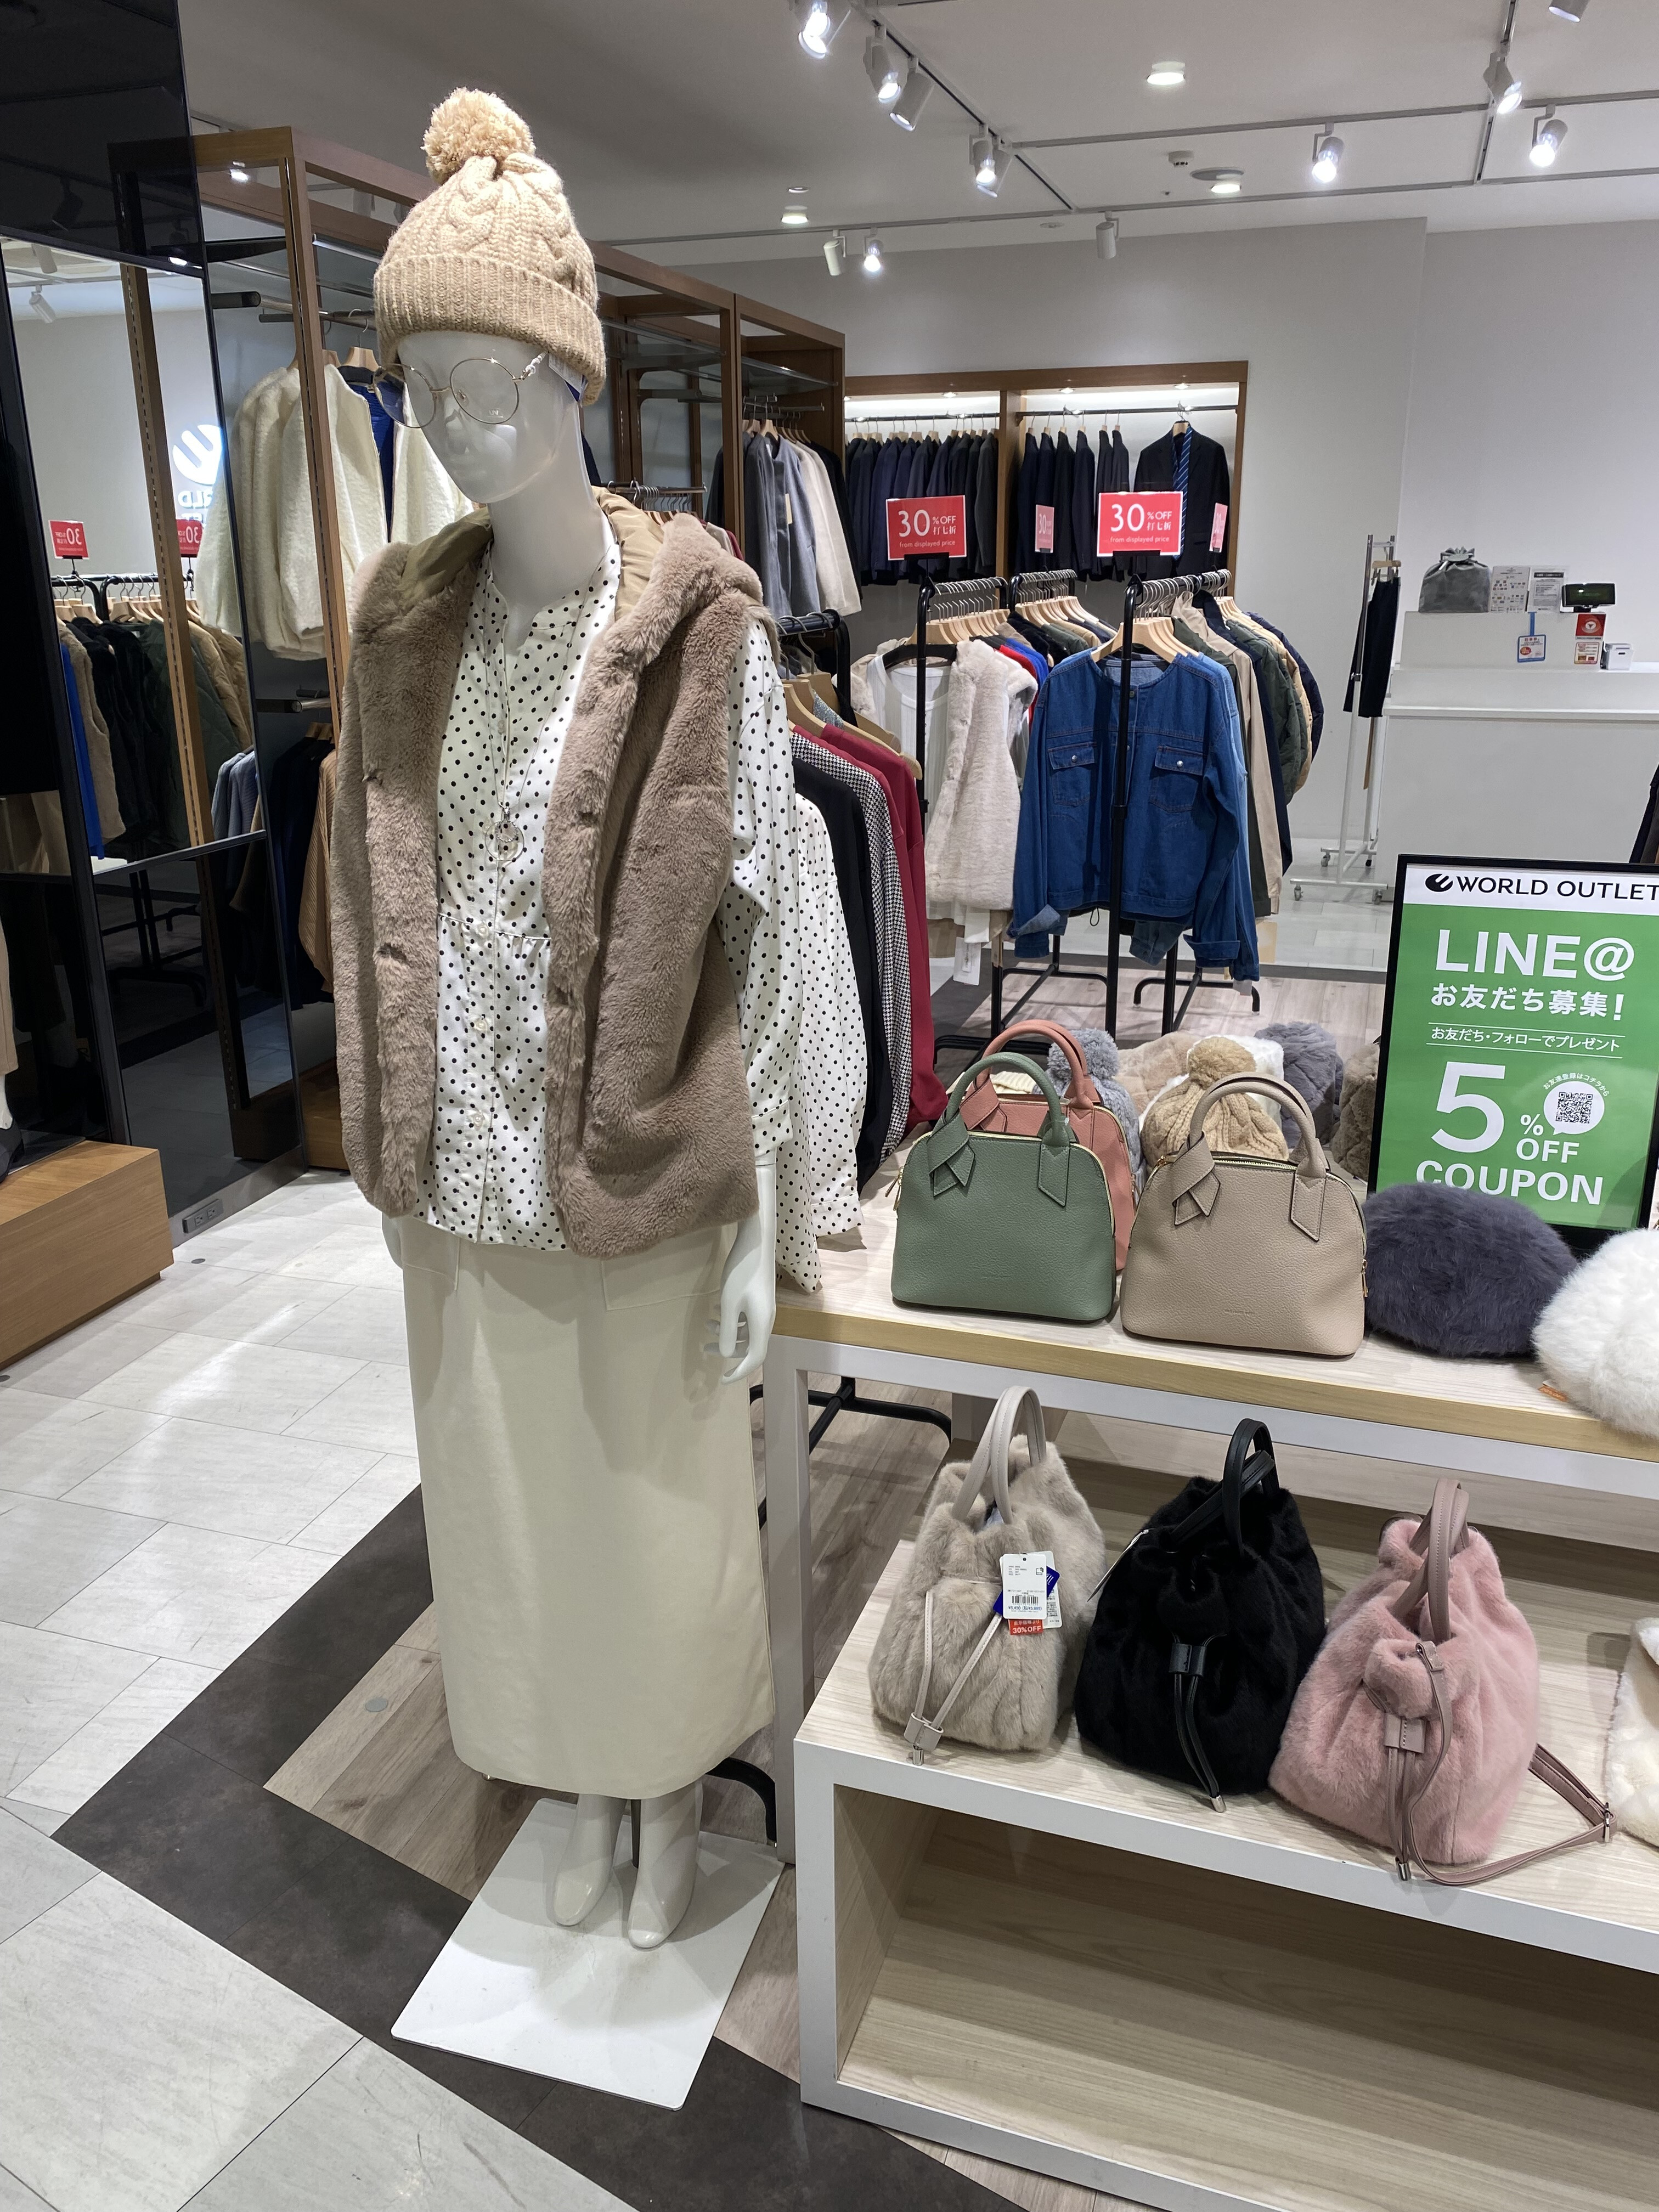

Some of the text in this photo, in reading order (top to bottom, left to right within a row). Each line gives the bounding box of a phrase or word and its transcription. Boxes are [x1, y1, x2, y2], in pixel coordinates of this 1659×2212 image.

[898, 509, 930, 537] 30
[1110, 503, 1145, 532] 30
[1456, 876, 1659, 901] WORLD OUTLET
[1435, 929, 1635, 981] LINE@
[1431, 983, 1625, 1021] お友だち募集!
[1431, 1061, 1506, 1153] 5
[1515, 1138, 1580, 1164] OFF
[1416, 1160, 1604, 1206] COUPON
[1012, 1626, 1042, 1634] 30%OFF
